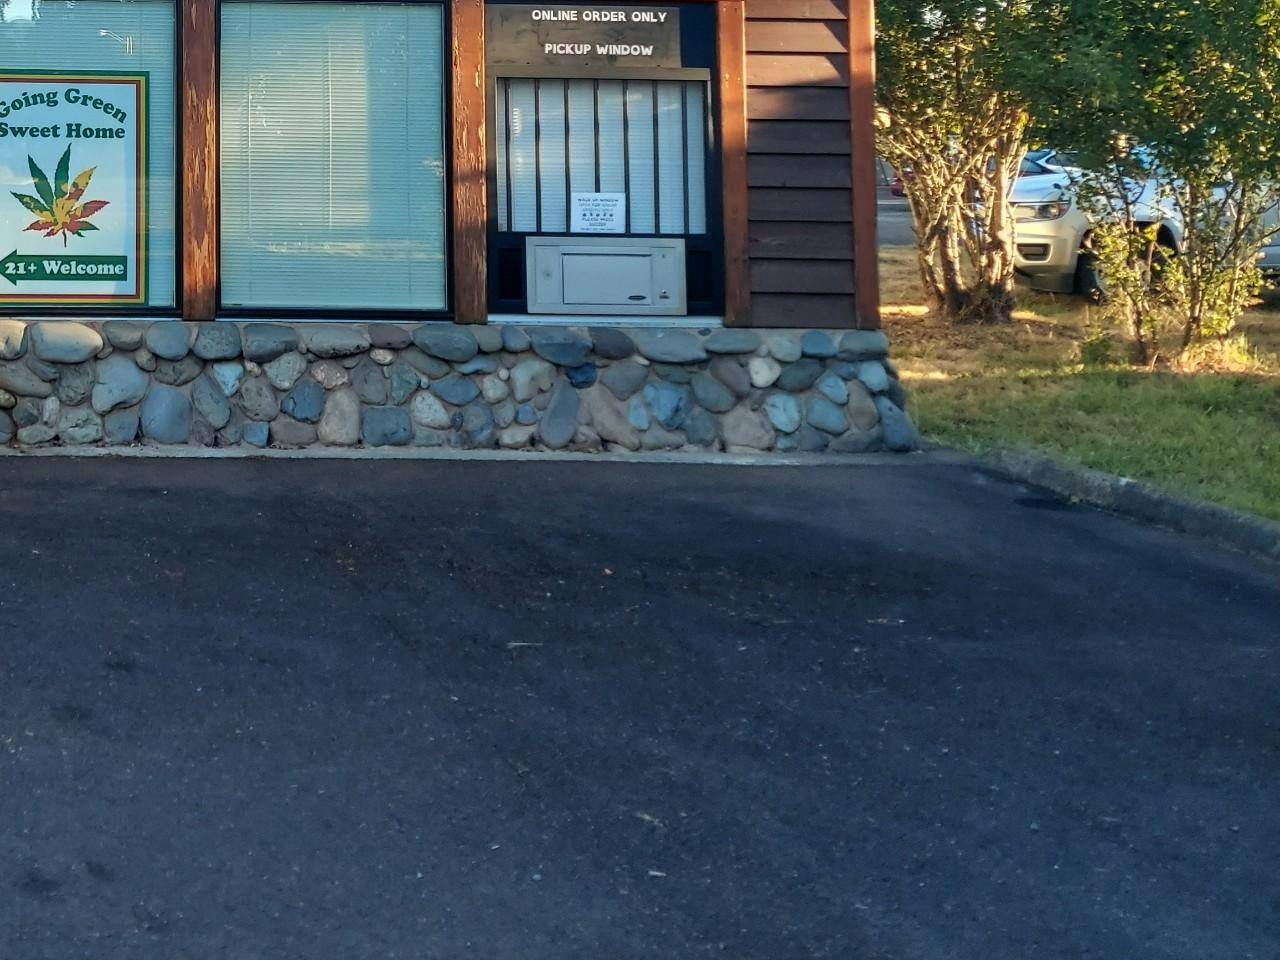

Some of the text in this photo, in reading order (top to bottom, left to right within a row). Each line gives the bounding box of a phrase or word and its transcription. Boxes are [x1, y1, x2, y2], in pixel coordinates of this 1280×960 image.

[532, 9, 667, 23] ONLINE ORDER ONLY
[544, 43, 654, 56] PICKUP WINDOW
[64, 88, 127, 123] Green
[65, 123, 126, 139] Home
[4, 260, 124, 275] 21+ Welcome
